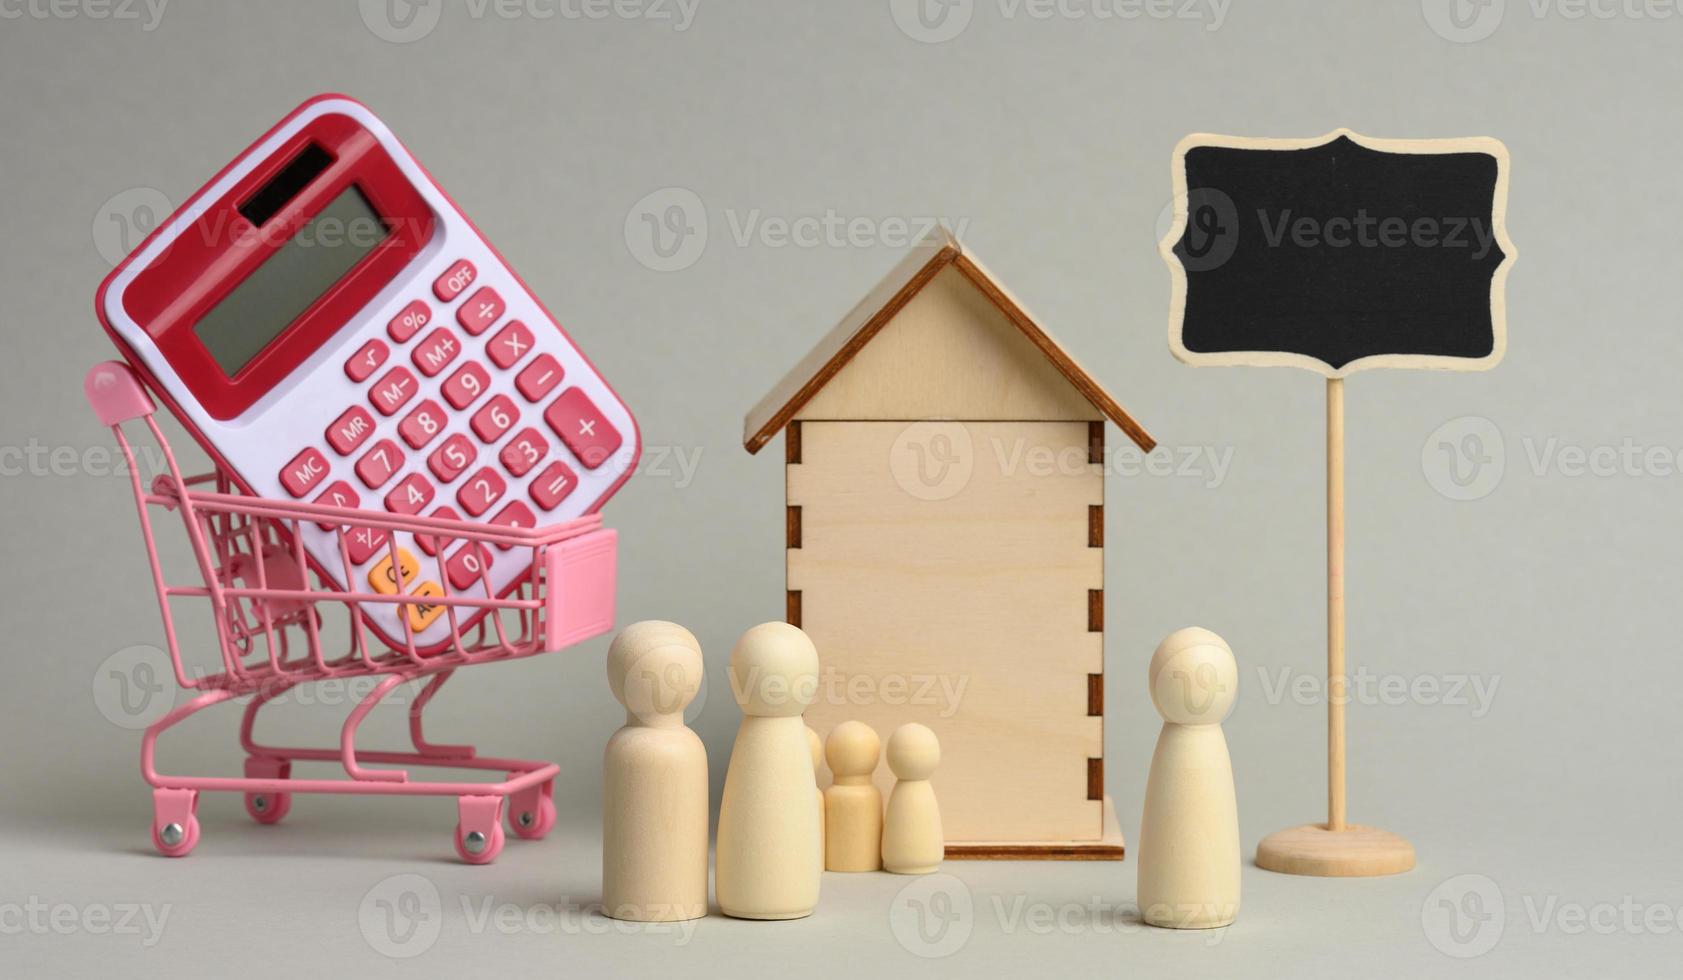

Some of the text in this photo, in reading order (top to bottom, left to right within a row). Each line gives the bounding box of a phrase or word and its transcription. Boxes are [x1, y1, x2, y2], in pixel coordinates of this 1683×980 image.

[447, 266, 473, 292] OFF
[403, 311, 427, 330] %
[425, 338, 454, 367] M+
[460, 372, 481, 396] 9
[341, 416, 369, 442] MR
[418, 412, 438, 434] 8
[490, 406, 510, 429] 6
[372, 449, 391, 472] 7
[445, 444, 466, 468] 5
[517, 440, 539, 463] 3
[295, 457, 323, 485] MC
[407, 484, 424, 505] 4
[475, 479, 497, 503] 2
[463, 553, 480, 573] 0
[416, 590, 438, 619] A
